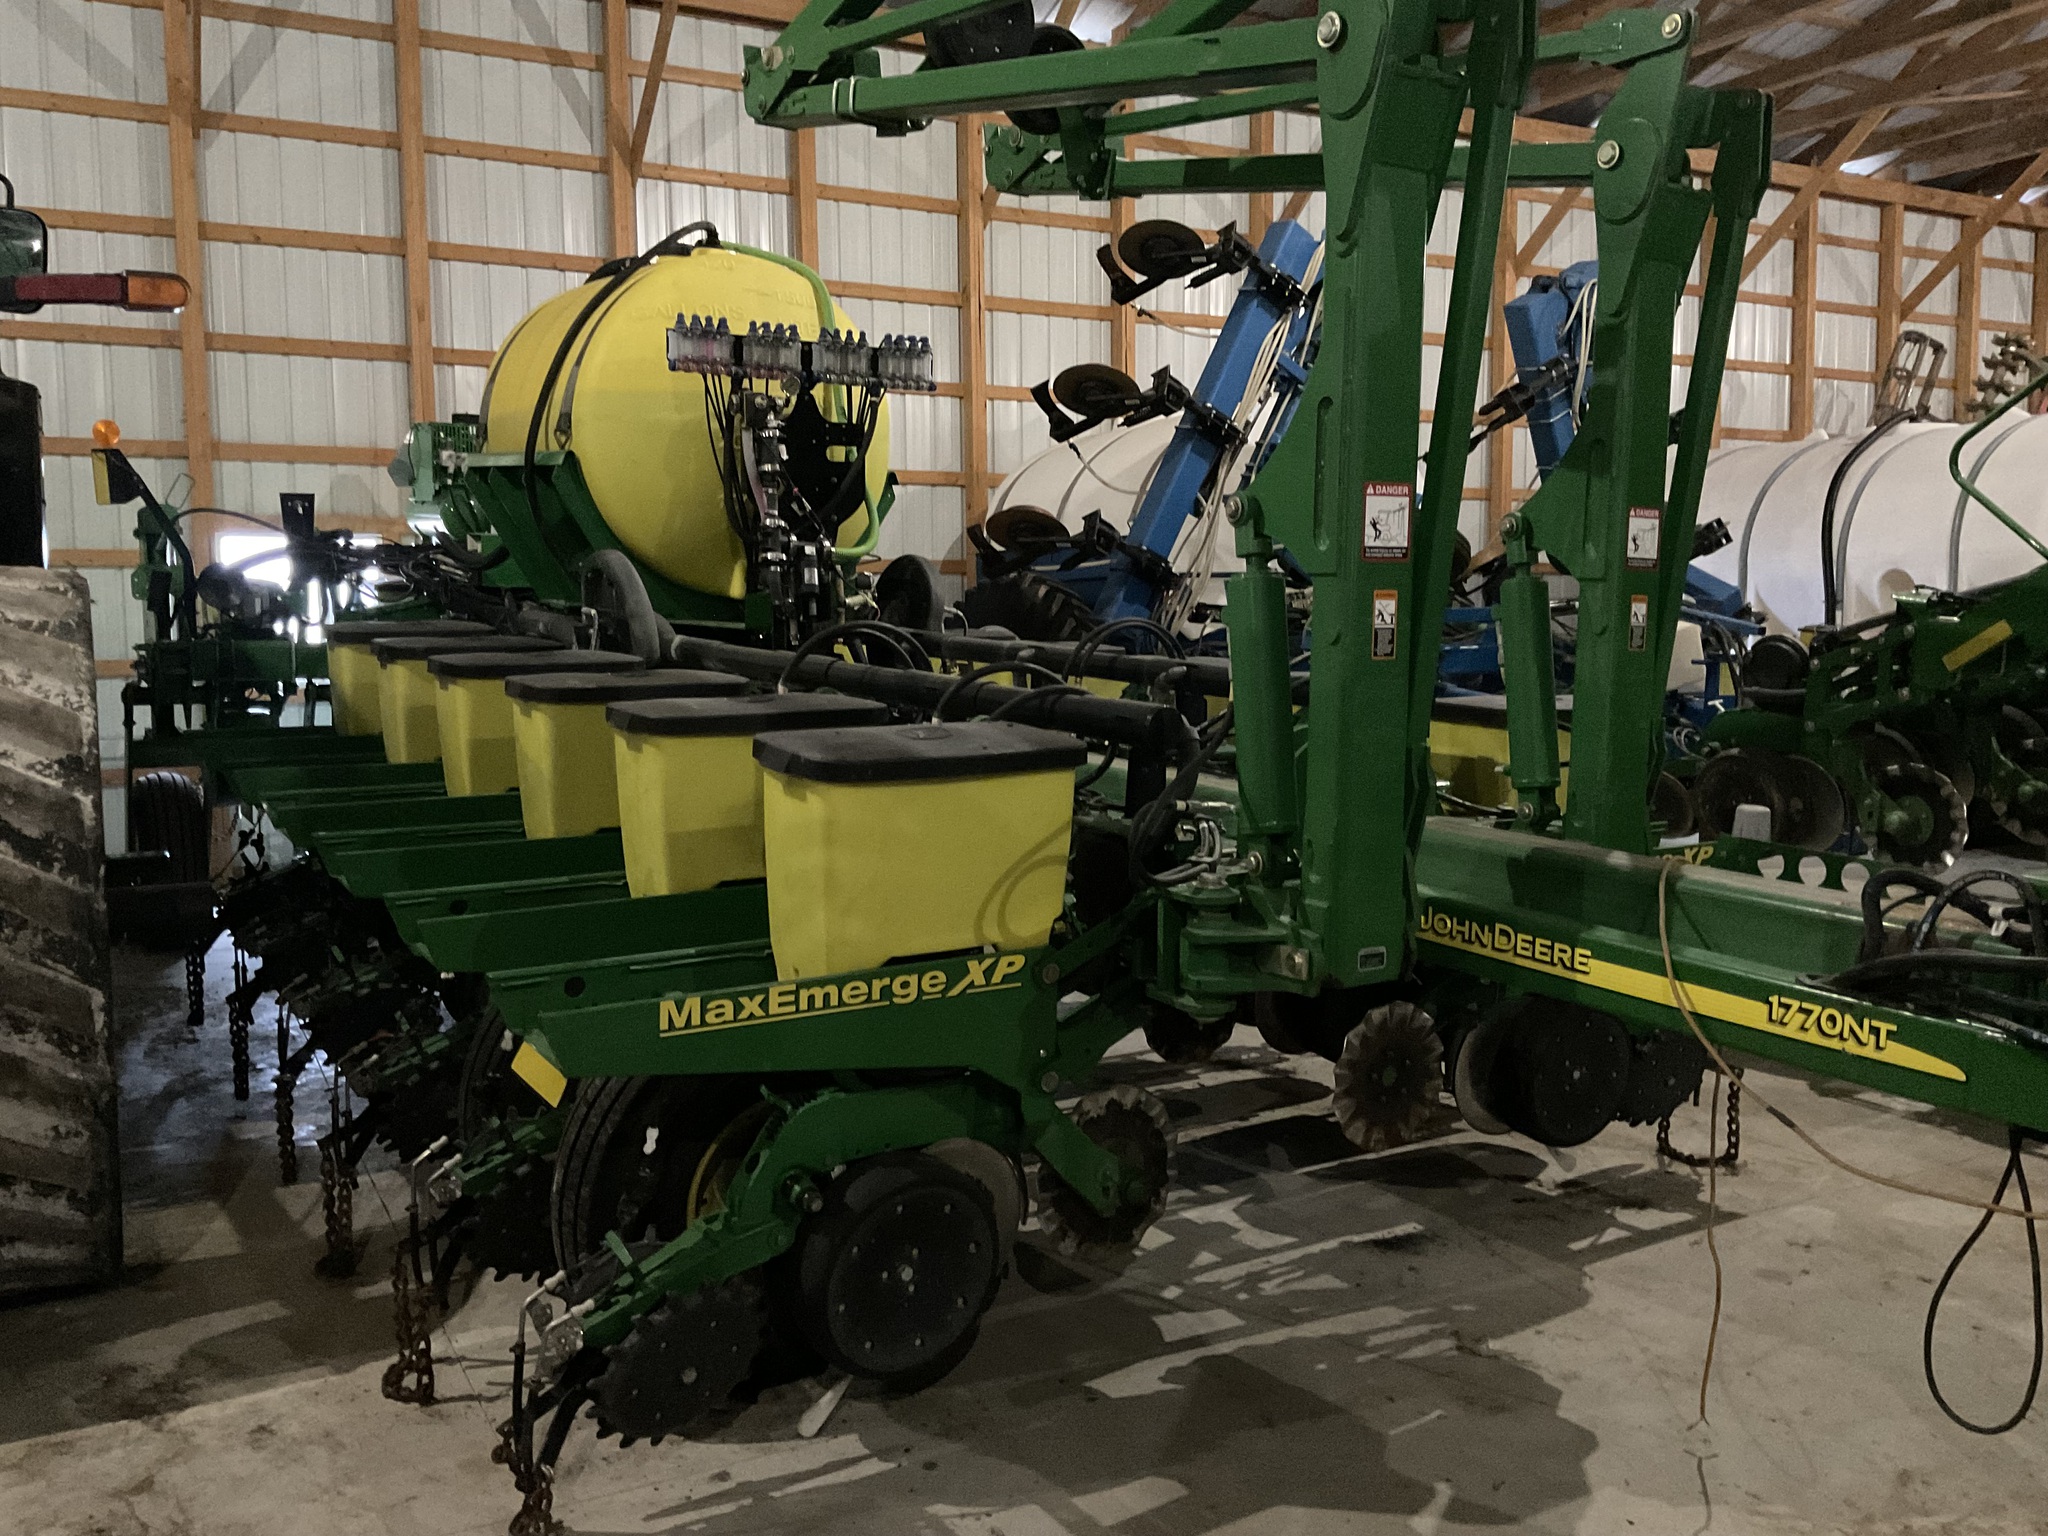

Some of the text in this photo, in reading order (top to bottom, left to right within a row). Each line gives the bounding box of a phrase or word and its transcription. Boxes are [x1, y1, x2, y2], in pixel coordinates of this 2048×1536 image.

[1375, 485, 1409, 495] DANGER
[1636, 508, 1660, 518] DANGER
[1420, 906, 1592, 974] JOHN DEERE
[659, 953, 1026, 1033] MaxEmerge XP
[1768, 994, 1898, 1050] 1770NT
